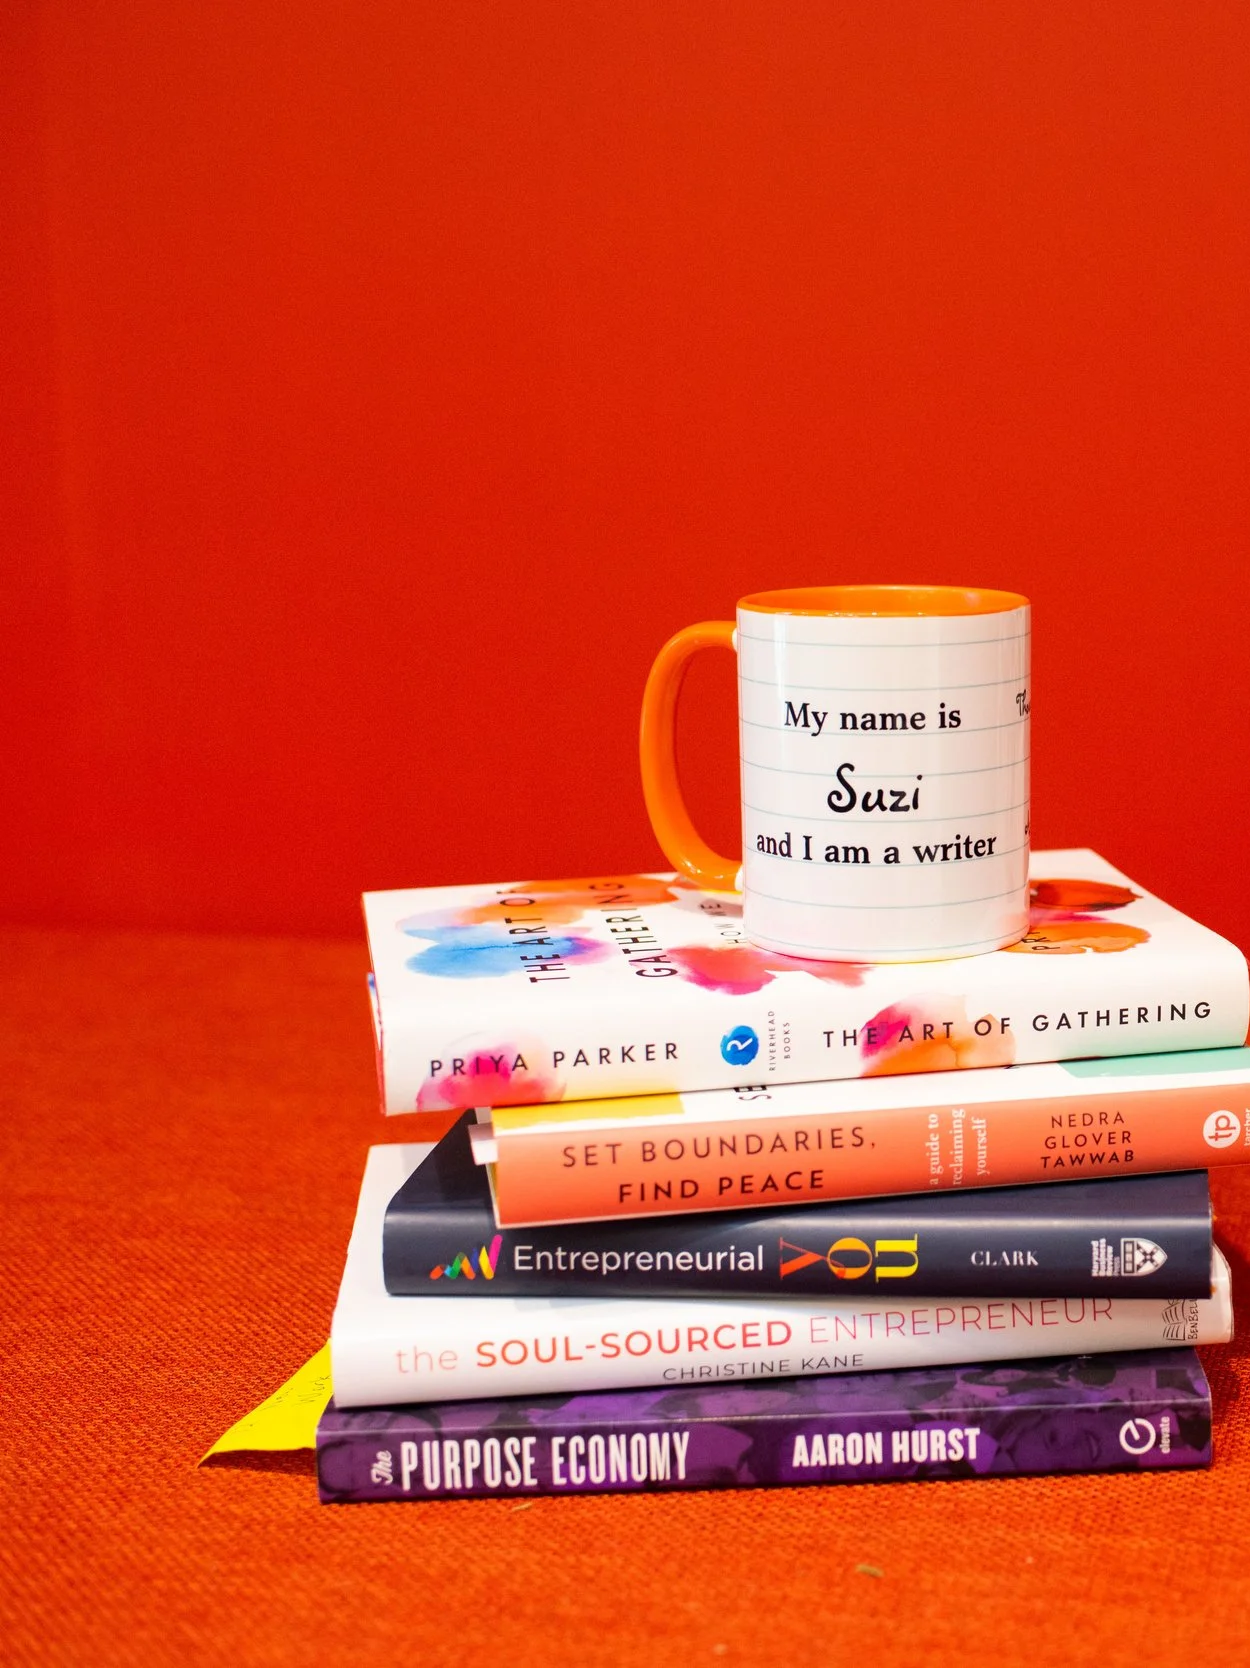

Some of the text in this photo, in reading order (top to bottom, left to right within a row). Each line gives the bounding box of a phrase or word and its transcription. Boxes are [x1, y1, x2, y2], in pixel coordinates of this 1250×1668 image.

[785, 701, 962, 736] My name is
[827, 763, 923, 813] Suzi
[757, 832, 997, 864] and I am a writer
[505, 917, 554, 945] ART
[588, 882, 679, 978] GATHERING
[520, 953, 570, 983] THE
[767, 1011, 777, 1071] RIVERHEAD
[783, 1022, 791, 1059] BOOKS
[823, 1001, 1213, 1048] THE ART OF GATHERING
[430, 1043, 679, 1077] PRIYA PARKER
[928, 1113, 939, 1129] to
[1051, 1111, 1125, 1129] NEDRA
[562, 1126, 877, 1168] SET BOUNDARIES,
[925, 1132, 944, 1175] guide
[949, 1108, 966, 1186] reclaiming
[971, 1116, 990, 1176] yourself
[1040, 1149, 1135, 1169] TAWWAB
[1044, 1131, 1132, 1150] GLOVER
[619, 1170, 824, 1204] FIND PEACE
[513, 1245, 764, 1275] Entrepreneurial
[971, 1250, 1040, 1267] CLARK
[395, 1298, 1114, 1375] the SOUL-SOURCED ENTREPRENEUR
[662, 1353, 865, 1382] CHRISTINE KANE
[792, 1427, 980, 1468] AARON HURST
[1159, 1416, 1171, 1454] elevate
[370, 1431, 690, 1491] The PURPOSE ECONOMY
